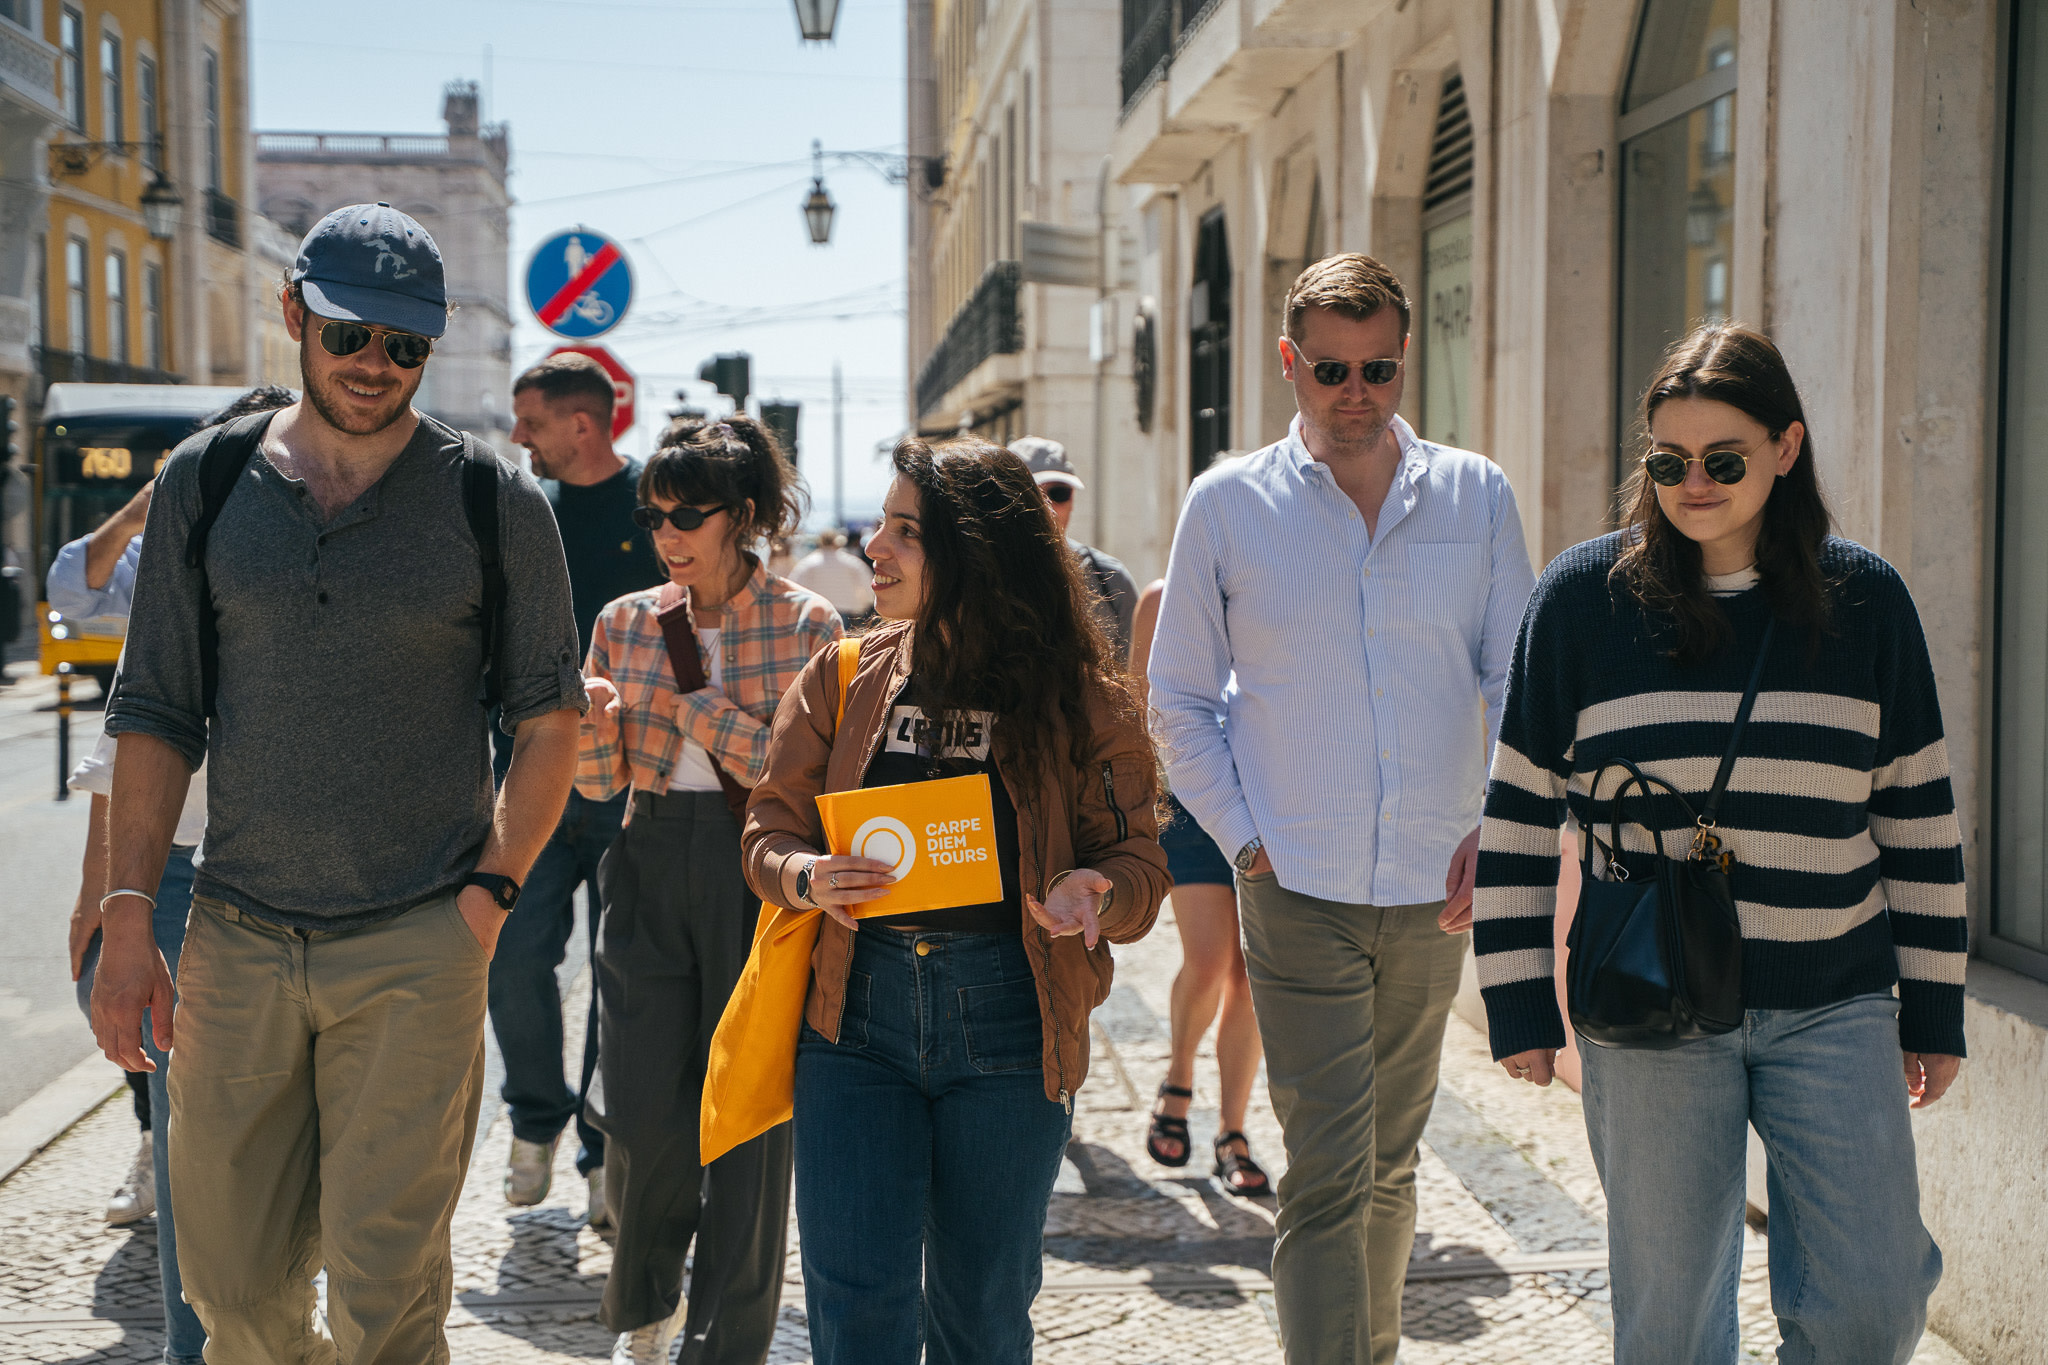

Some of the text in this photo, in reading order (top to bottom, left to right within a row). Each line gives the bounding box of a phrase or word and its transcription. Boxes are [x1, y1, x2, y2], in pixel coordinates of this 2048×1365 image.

[79, 448, 132, 479] 760
[926, 818, 981, 836] CARPE
[927, 835, 967, 851] DIEM
[929, 848, 987, 866] TOURS
